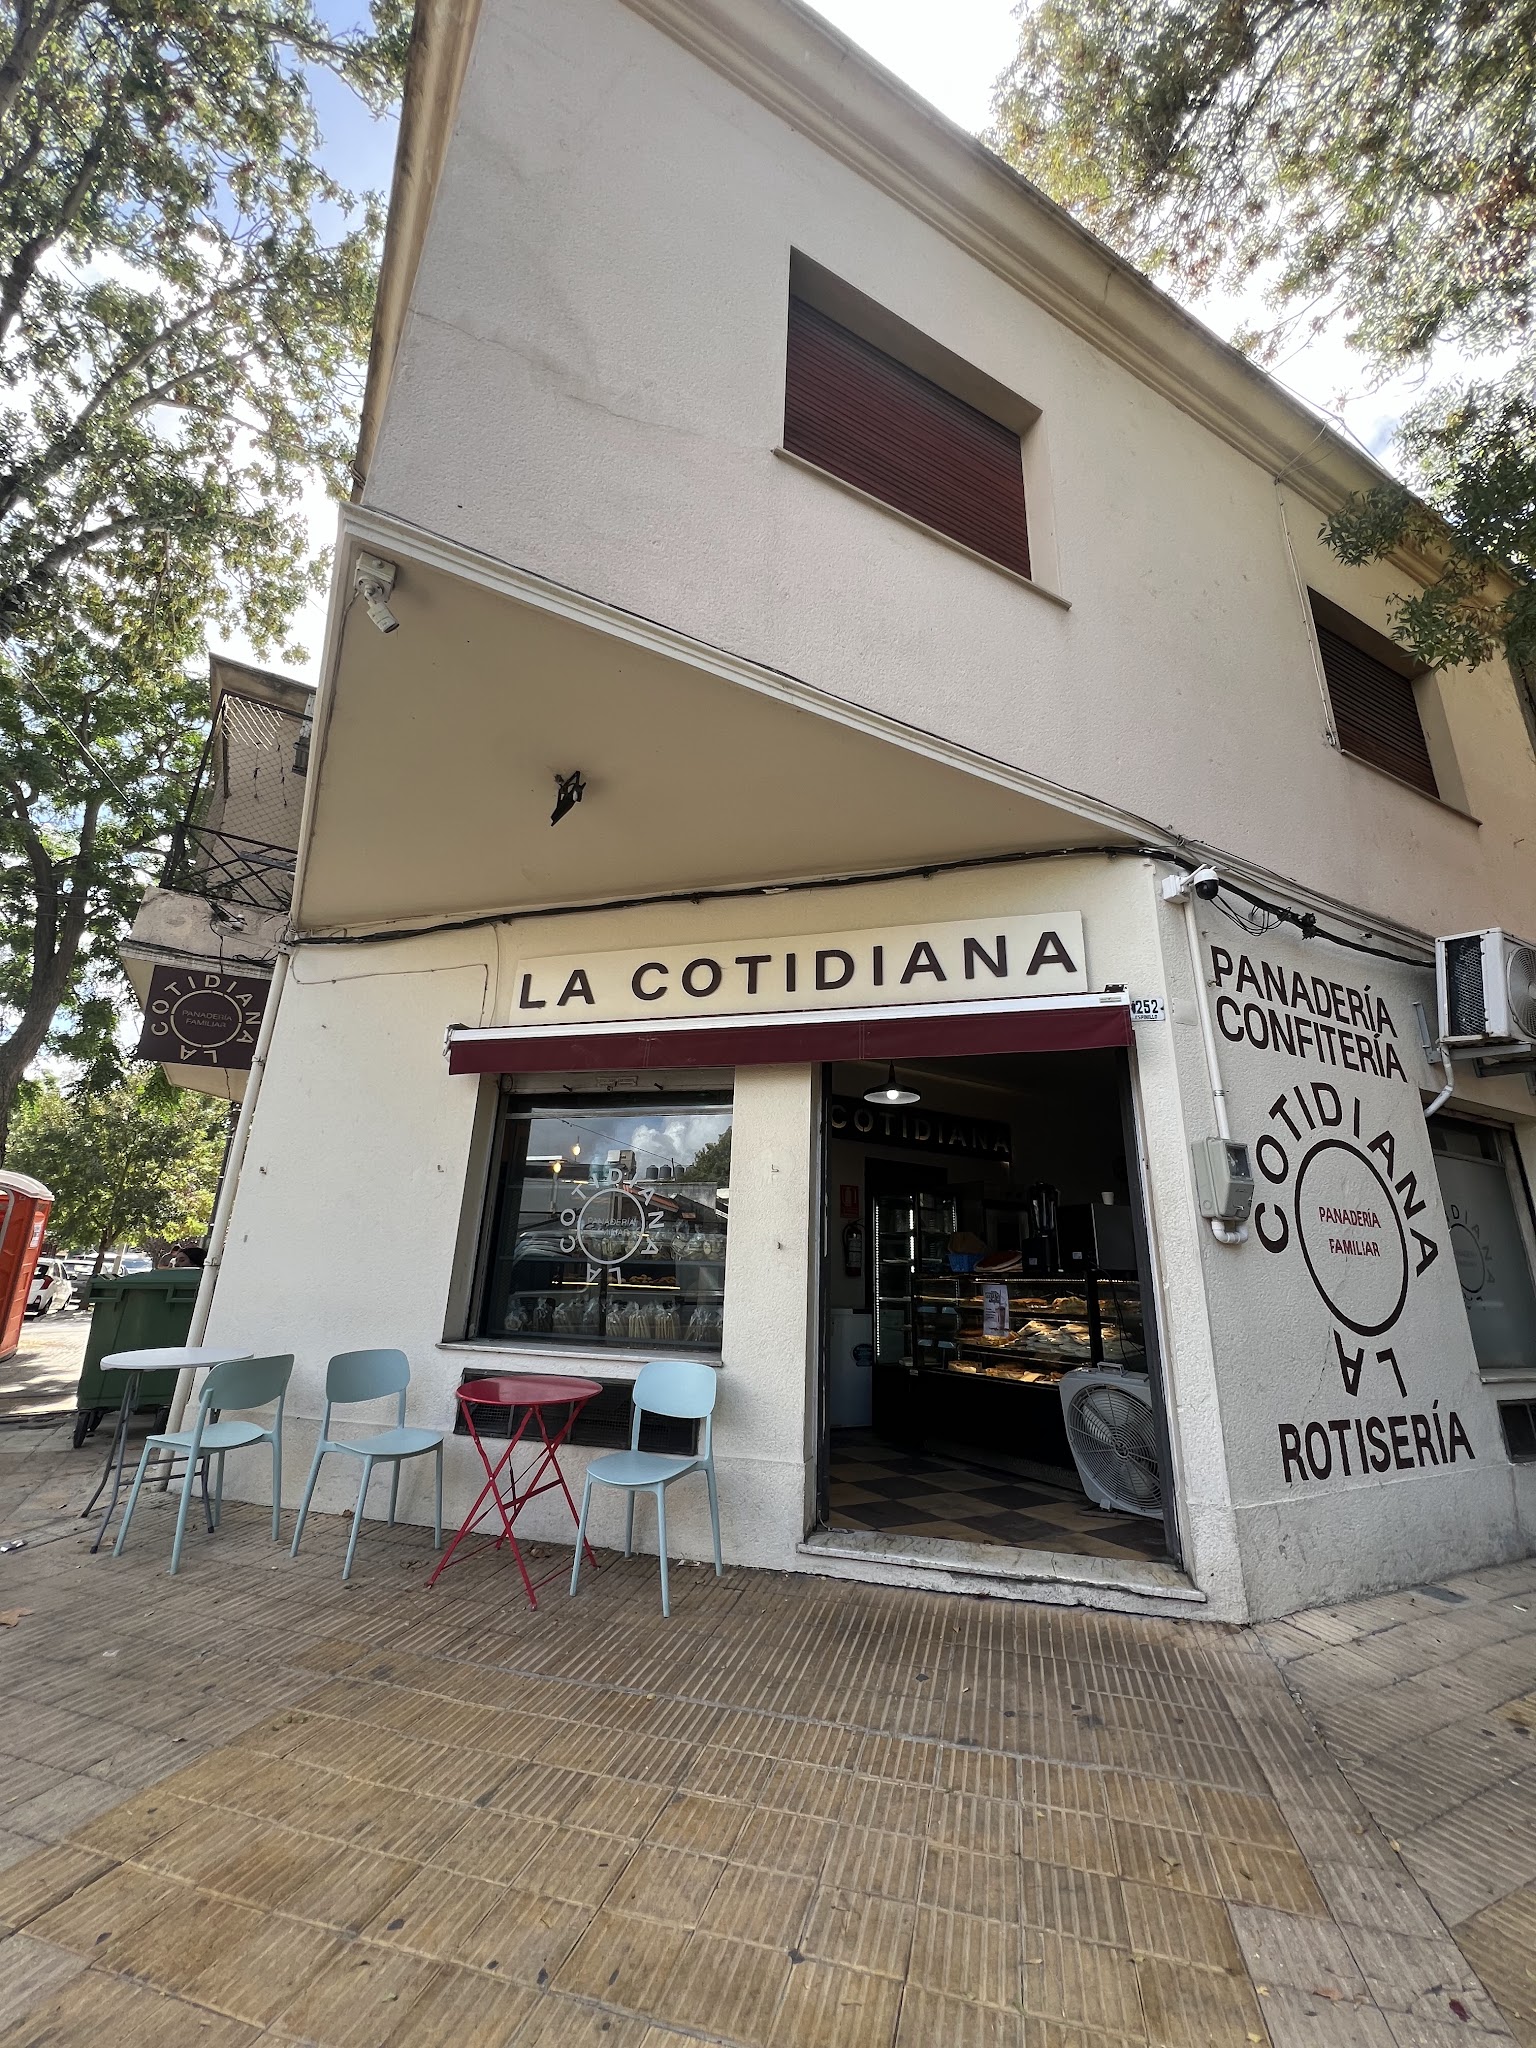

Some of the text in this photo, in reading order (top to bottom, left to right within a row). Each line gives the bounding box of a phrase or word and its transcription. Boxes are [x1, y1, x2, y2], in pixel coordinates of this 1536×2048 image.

[521, 931, 1077, 1010] LA COTIDIANA
[1210, 944, 1398, 1038] PANADERÍA
[151, 974, 261, 1043] COTIDIANA
[186, 1018, 227, 1028] FAMILIAR
[1216, 995, 1407, 1083] CONFITERÍA
[180, 1044, 218, 1064] LA
[831, 1104, 1010, 1153] COTIDIANA
[559, 1167, 665, 1256] COTIDIANA
[1255, 1081, 1439, 1278] COTIDIANA
[1318, 1206, 1382, 1228] PANADERÍA
[1328, 1238, 1381, 1257] FAMILIAR
[586, 1262, 622, 1285] LA
[1332, 1327, 1408, 1398] LA
[1277, 1400, 1476, 1484] ROTISERÍA
